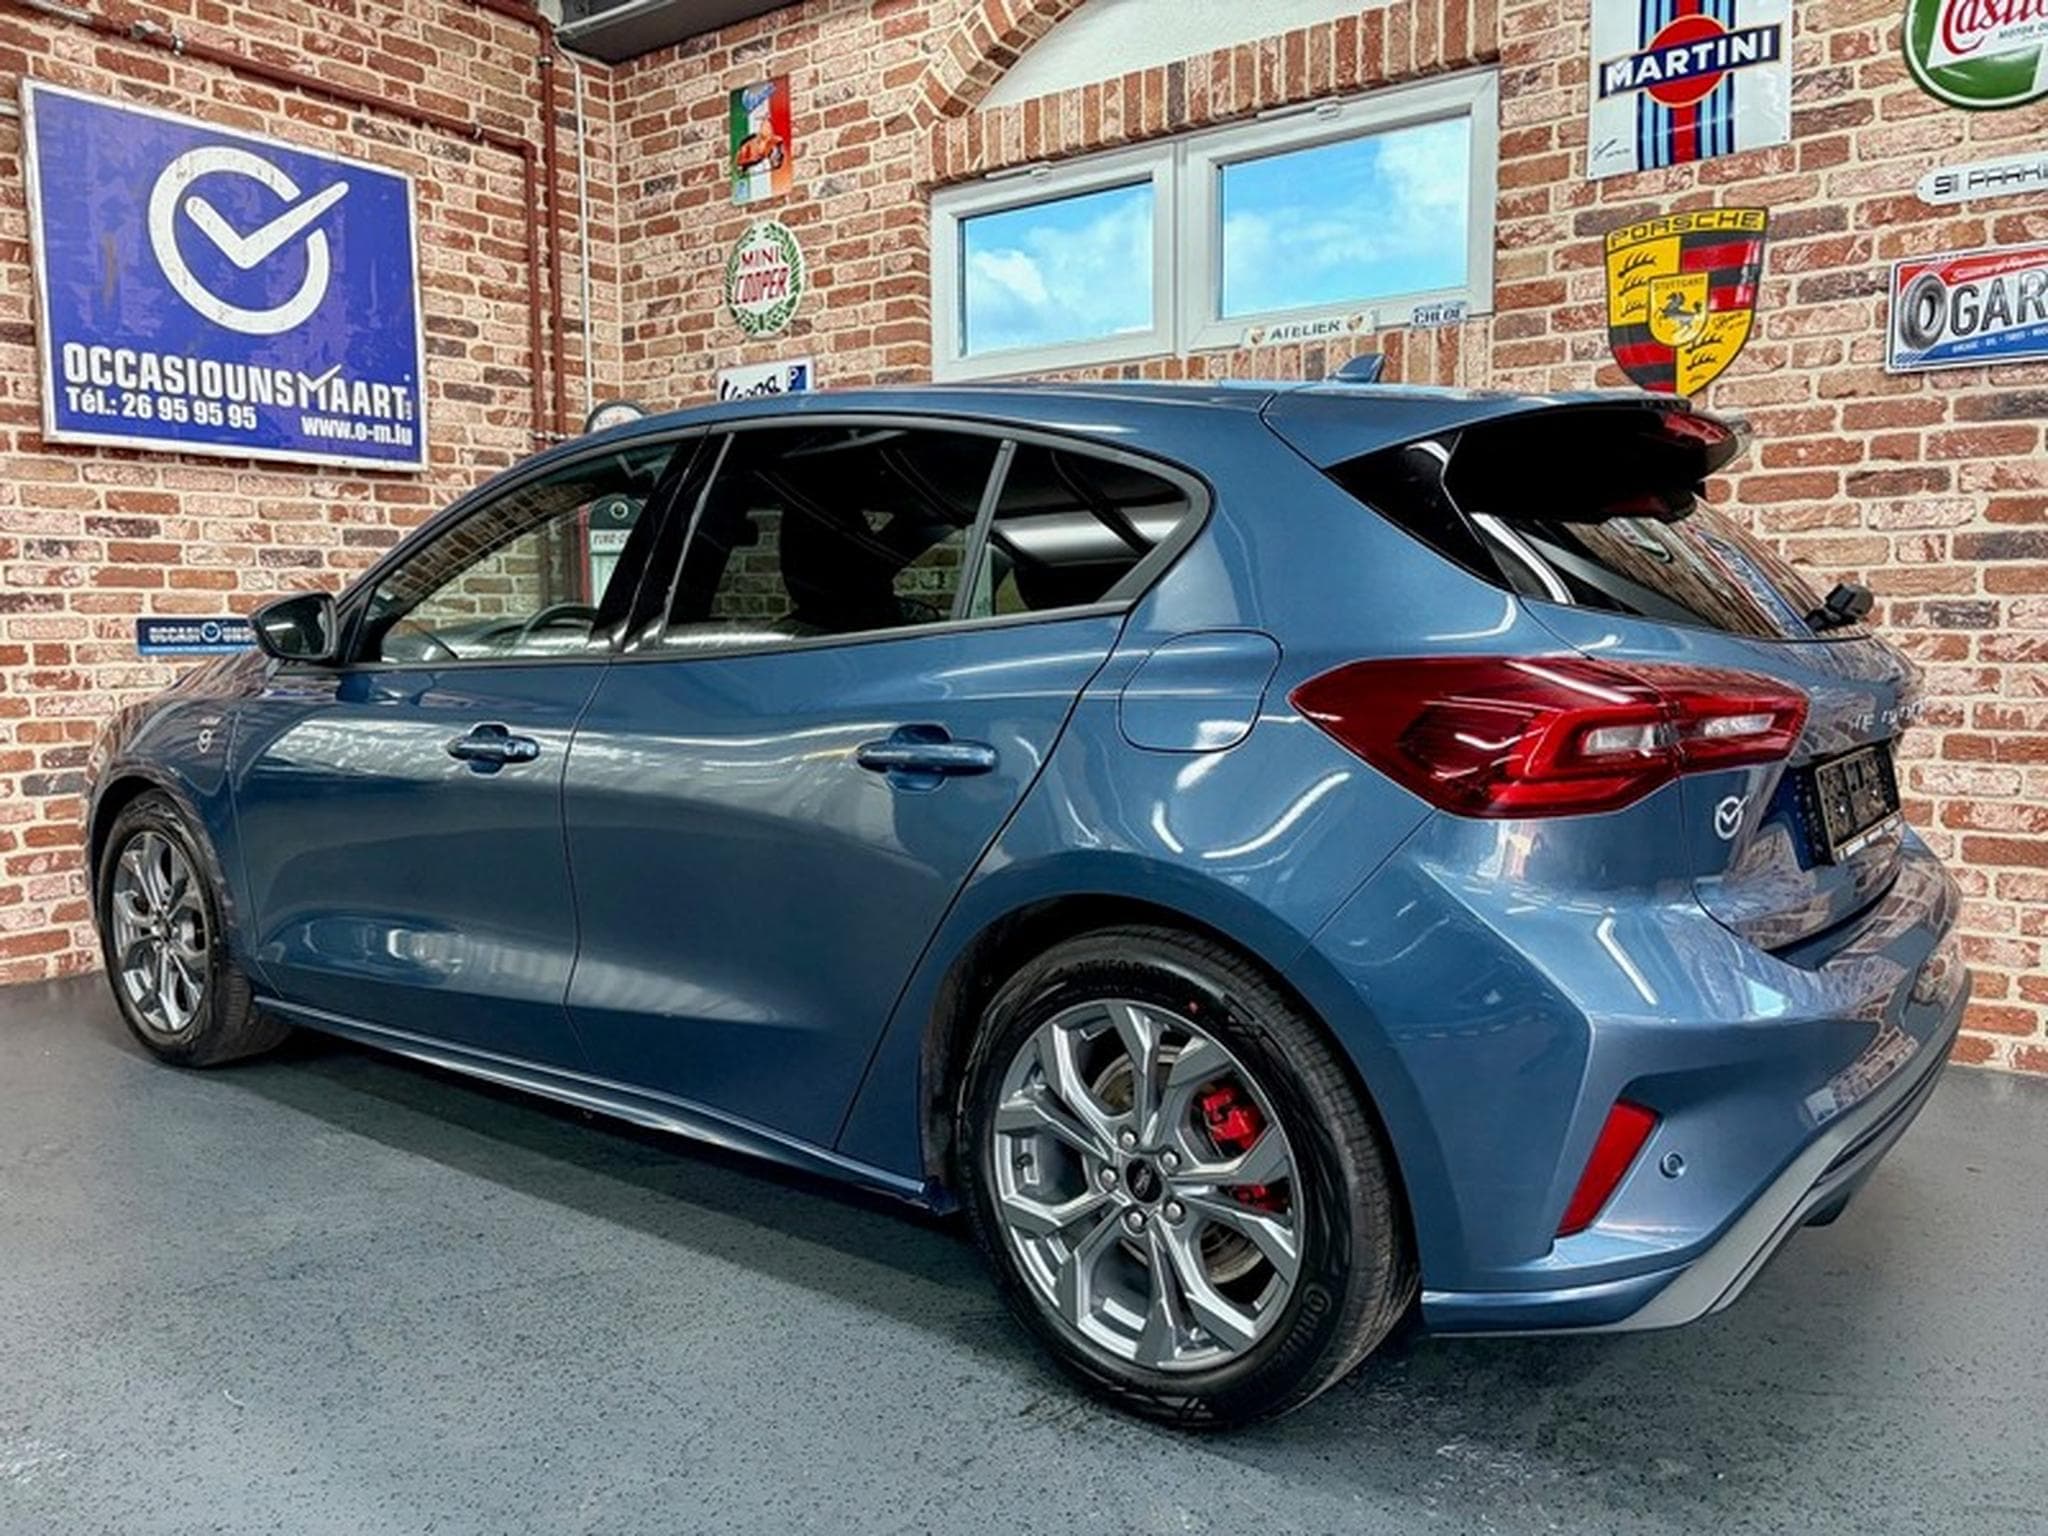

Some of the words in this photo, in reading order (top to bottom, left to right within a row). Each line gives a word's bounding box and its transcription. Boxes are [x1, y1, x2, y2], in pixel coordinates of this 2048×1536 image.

[1605, 30, 1773, 94] MARTINI
[1610, 211, 1762, 248] PORSCHE
[740, 246, 780, 269] MINI
[734, 266, 788, 305] COOPER
[1269, 319, 1341, 341] ATELIER
[66, 387, 117, 416] Tél.:
[121, 392, 155, 420] 26
[157, 396, 190, 423] 95
[193, 400, 225, 427] 95
[228, 404, 257, 430] 95
[301, 414, 413, 447] www.o-m.lu
